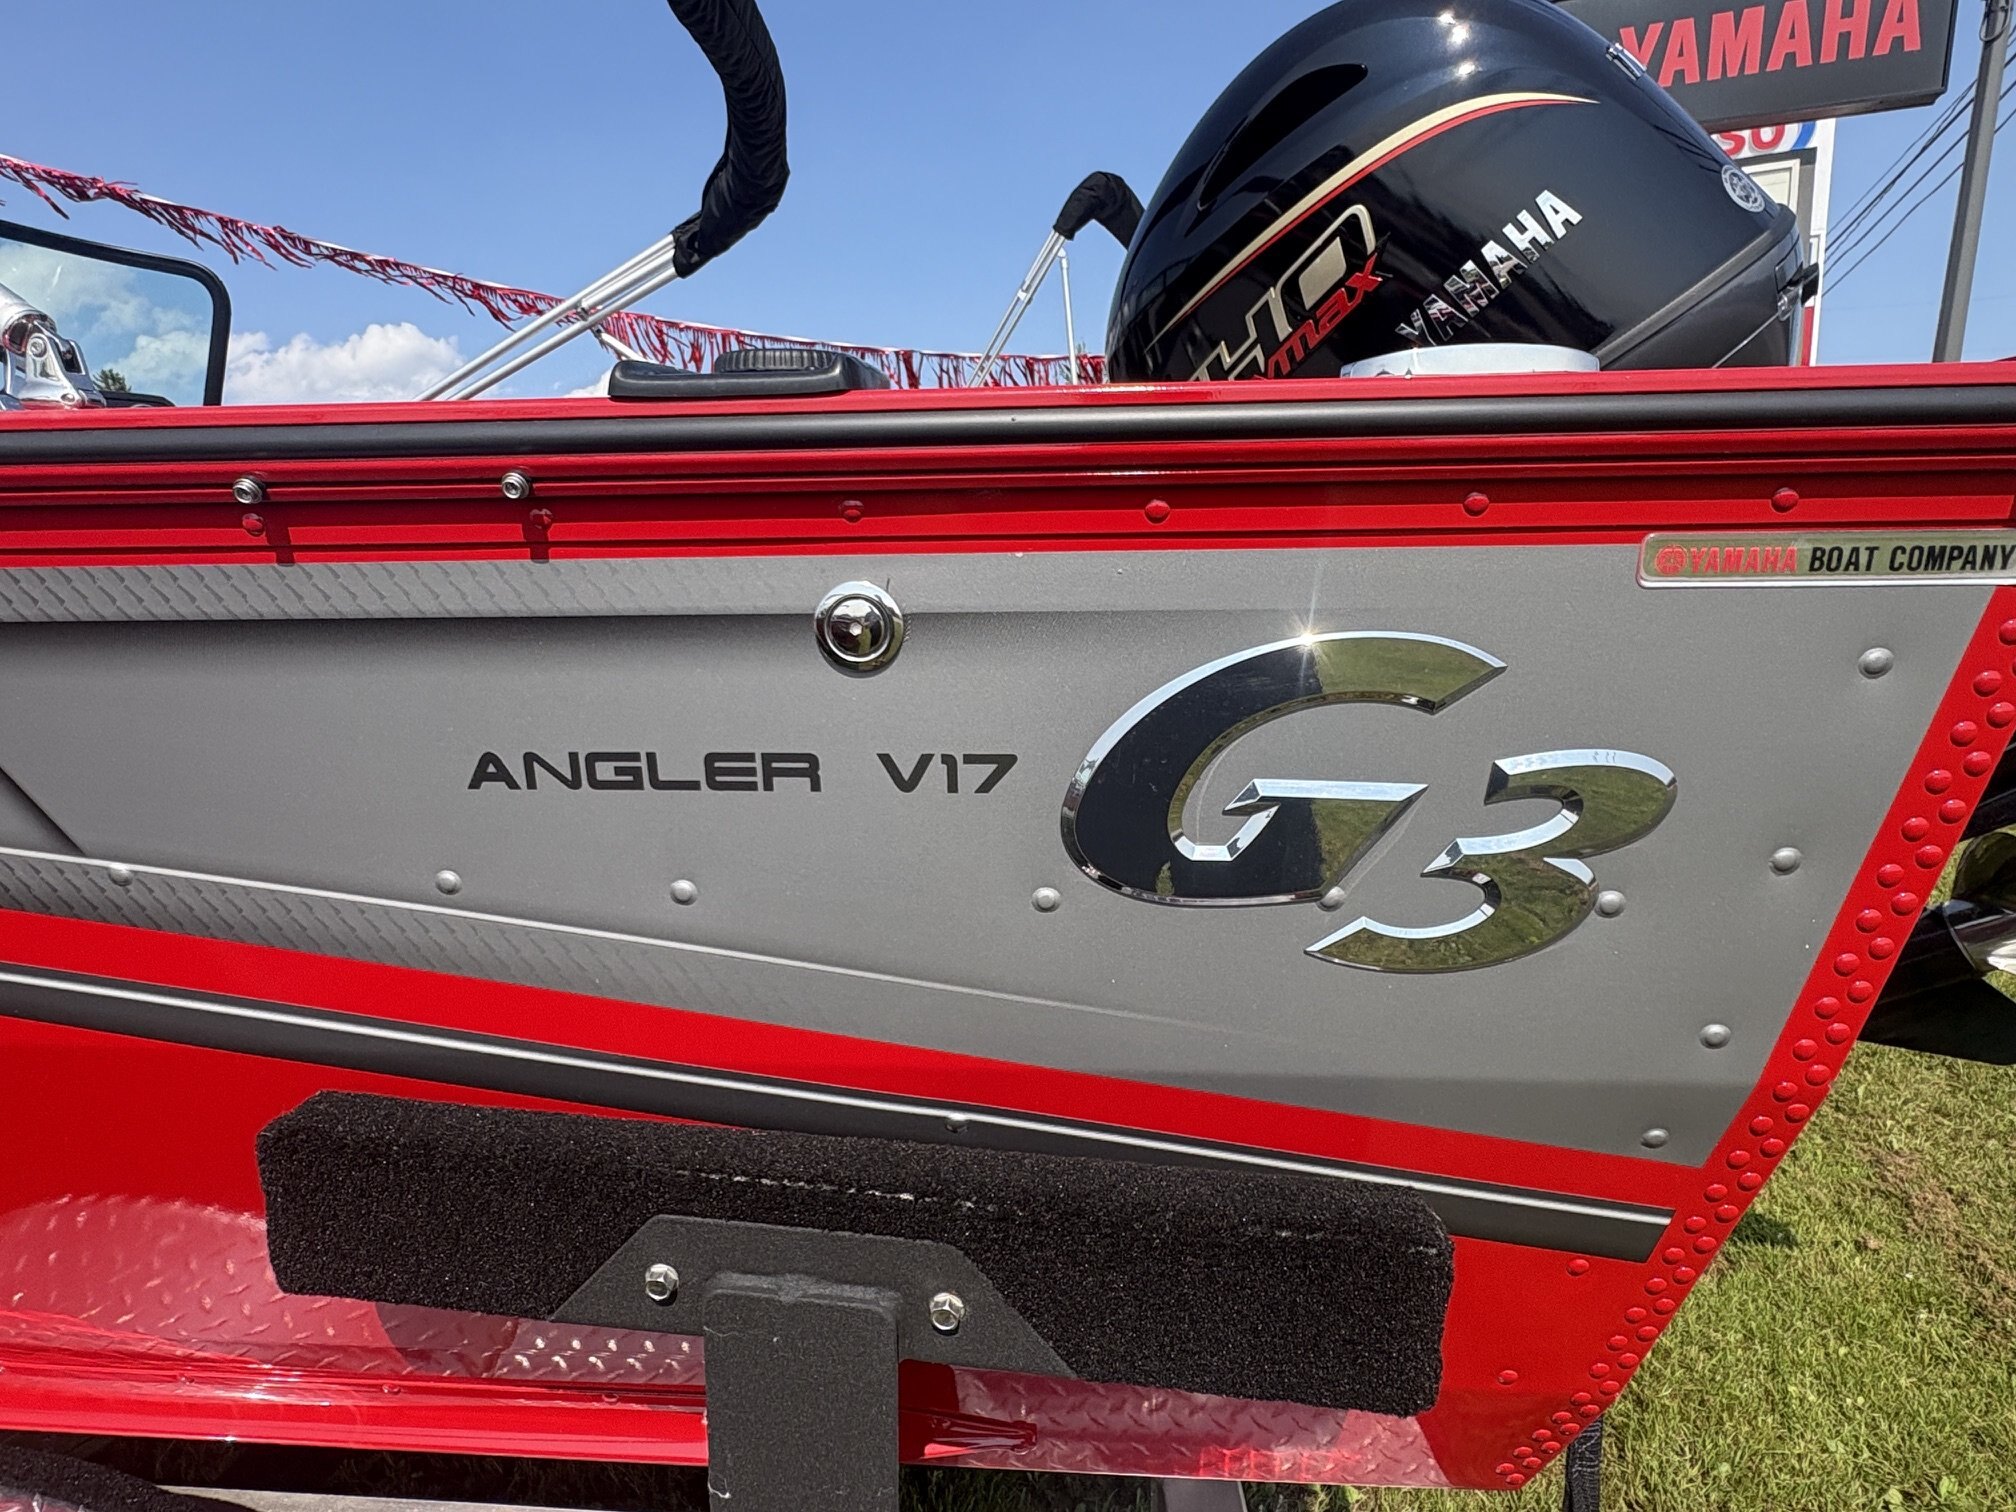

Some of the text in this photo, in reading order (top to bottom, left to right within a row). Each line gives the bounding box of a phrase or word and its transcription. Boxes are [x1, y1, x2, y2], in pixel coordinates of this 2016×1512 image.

[1619, 0, 1921, 87] YAMAHA
[1252, 252, 1384, 380] max
[1394, 189, 1583, 347] YAMAHA
[1690, 544, 2016, 574] YAMAHA BOAT COMPANY
[467, 751, 1018, 794] ANGLER V17
[1060, 630, 1678, 974] G3
